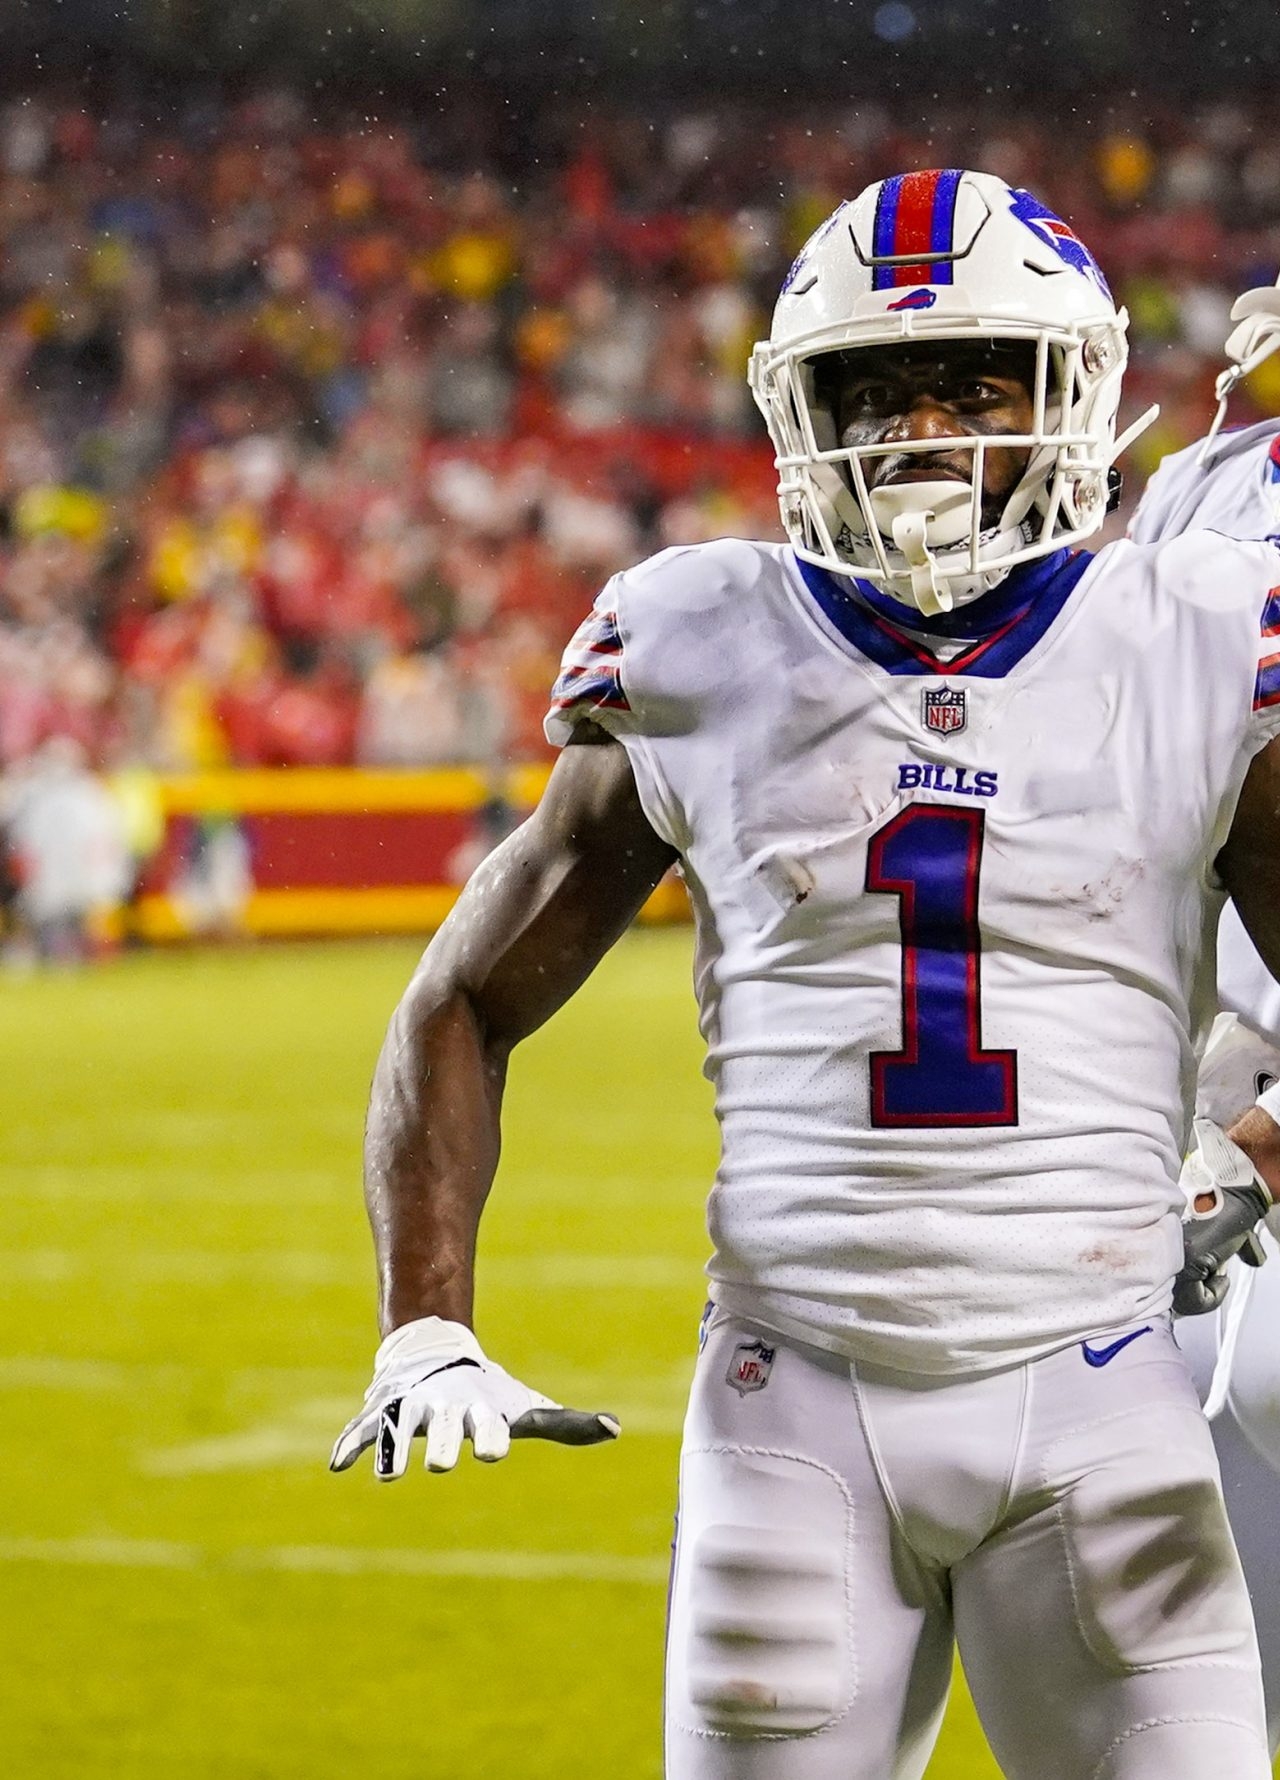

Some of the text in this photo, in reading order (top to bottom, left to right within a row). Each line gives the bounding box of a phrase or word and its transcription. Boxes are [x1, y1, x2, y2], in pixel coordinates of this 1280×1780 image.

[929, 706, 962, 730] NFL
[898, 763, 998, 797] BILLS
[864, 802, 1019, 1128] 1
